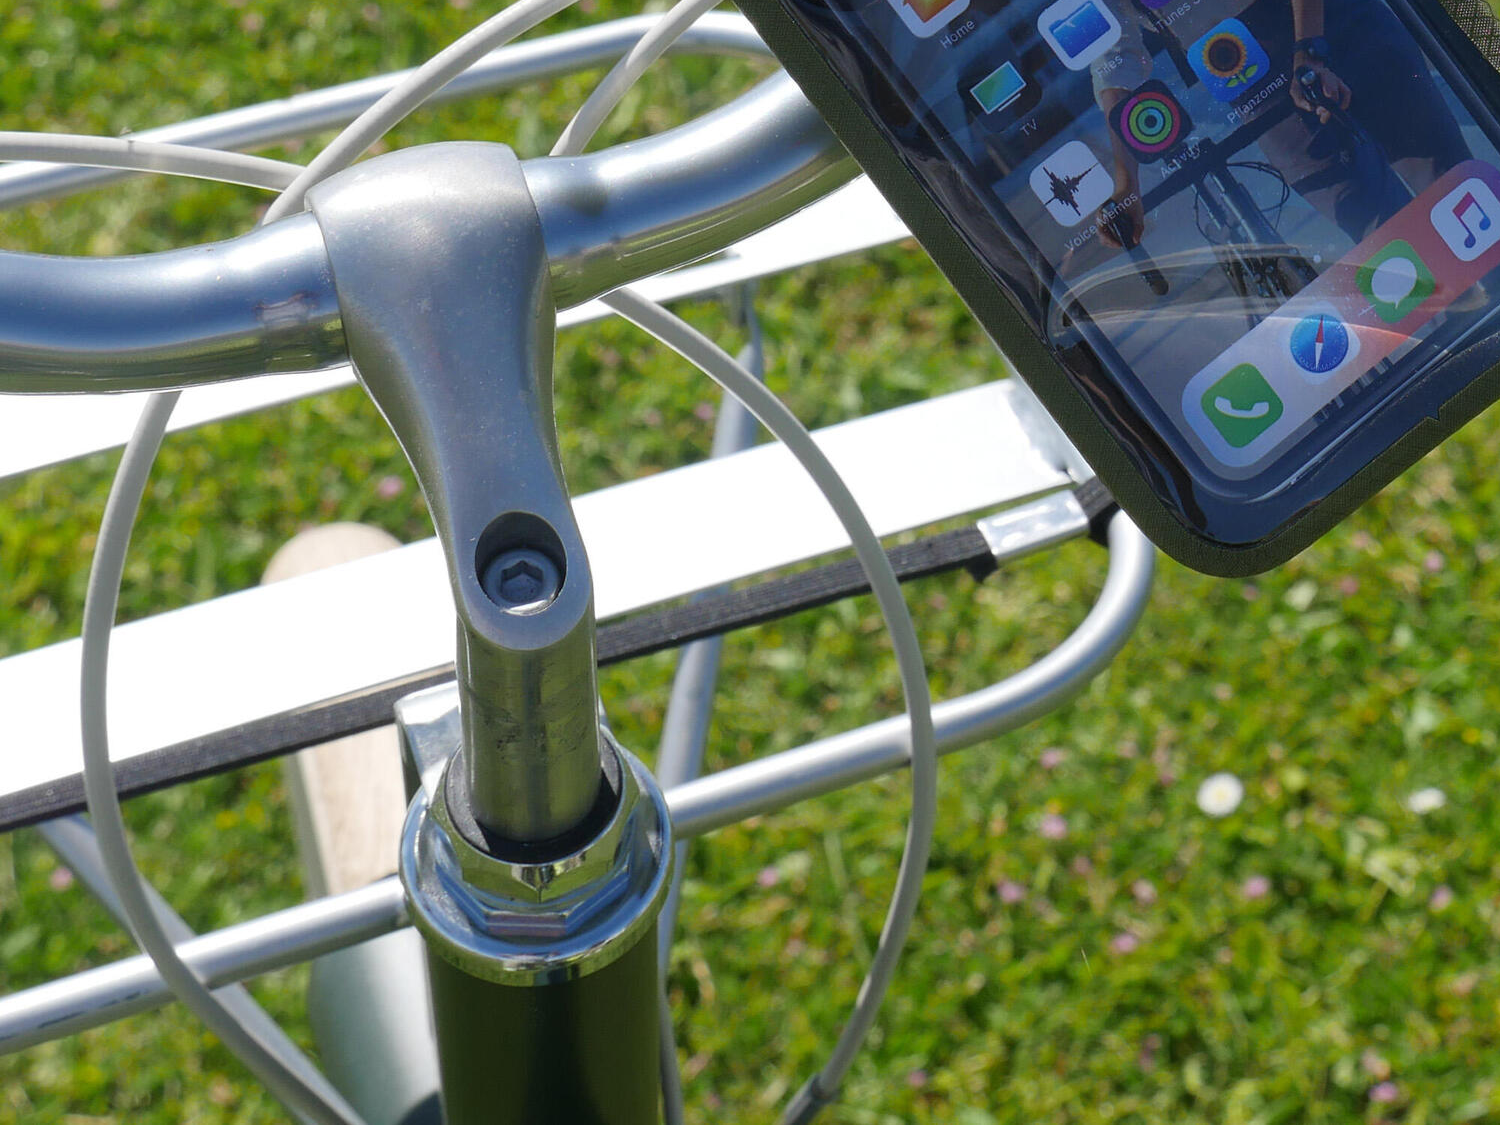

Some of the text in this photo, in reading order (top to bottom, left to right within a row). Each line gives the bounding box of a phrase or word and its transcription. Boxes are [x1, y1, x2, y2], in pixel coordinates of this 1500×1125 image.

[940, 18, 976, 50] Home
[1226, 73, 1289, 124] Pflanzomat
[1019, 118, 1038, 137] TV
[1159, 143, 1203, 179] Activity
[1064, 192, 1139, 252] Voice Memos
